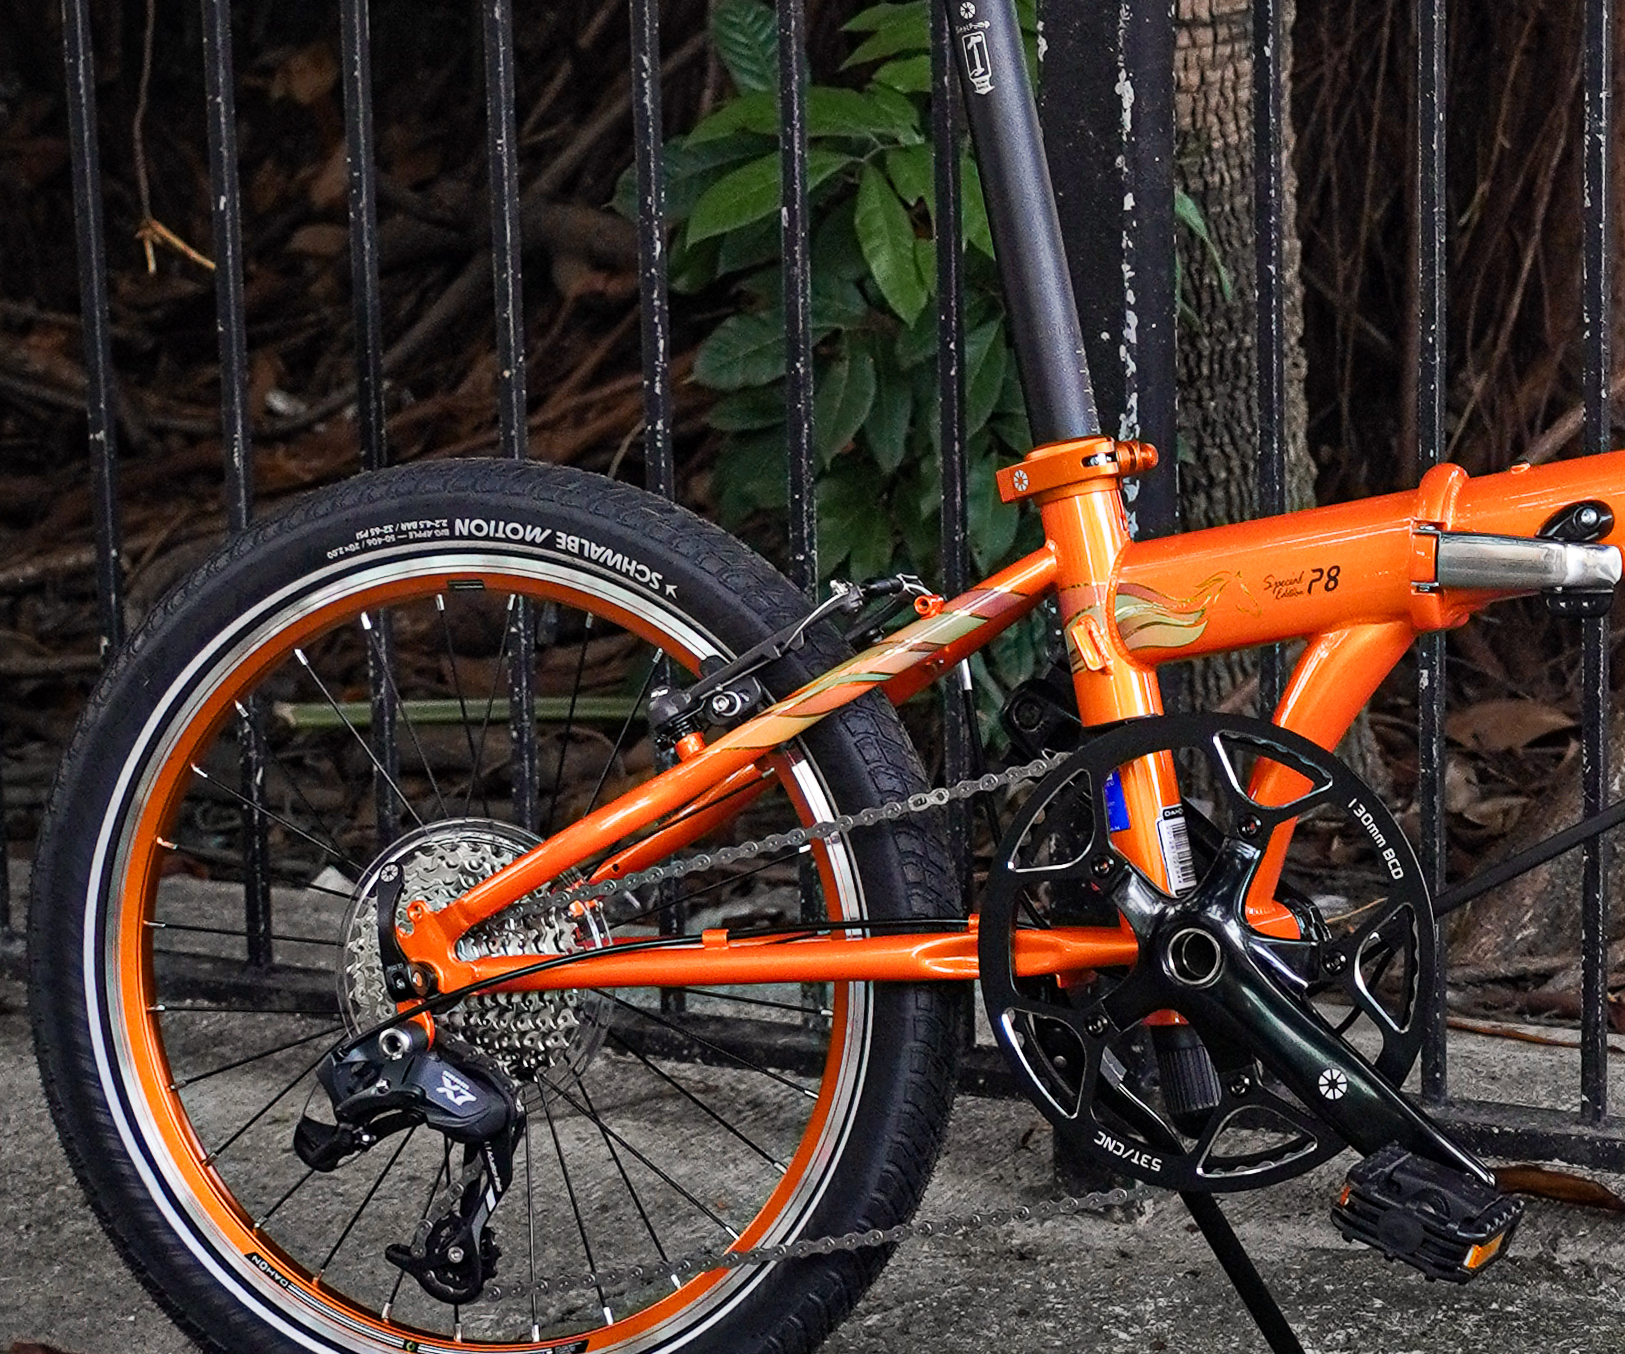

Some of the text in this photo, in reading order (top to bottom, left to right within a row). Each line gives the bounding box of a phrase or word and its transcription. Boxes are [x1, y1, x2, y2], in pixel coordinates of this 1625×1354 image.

[454, 518, 663, 590] SCHWALBE MOTION
[1348, 798, 1404, 880] 130mm BCD
[1094, 1131, 1162, 1172] 53T/CNC
[251, 1255, 289, 1287] DAHON
